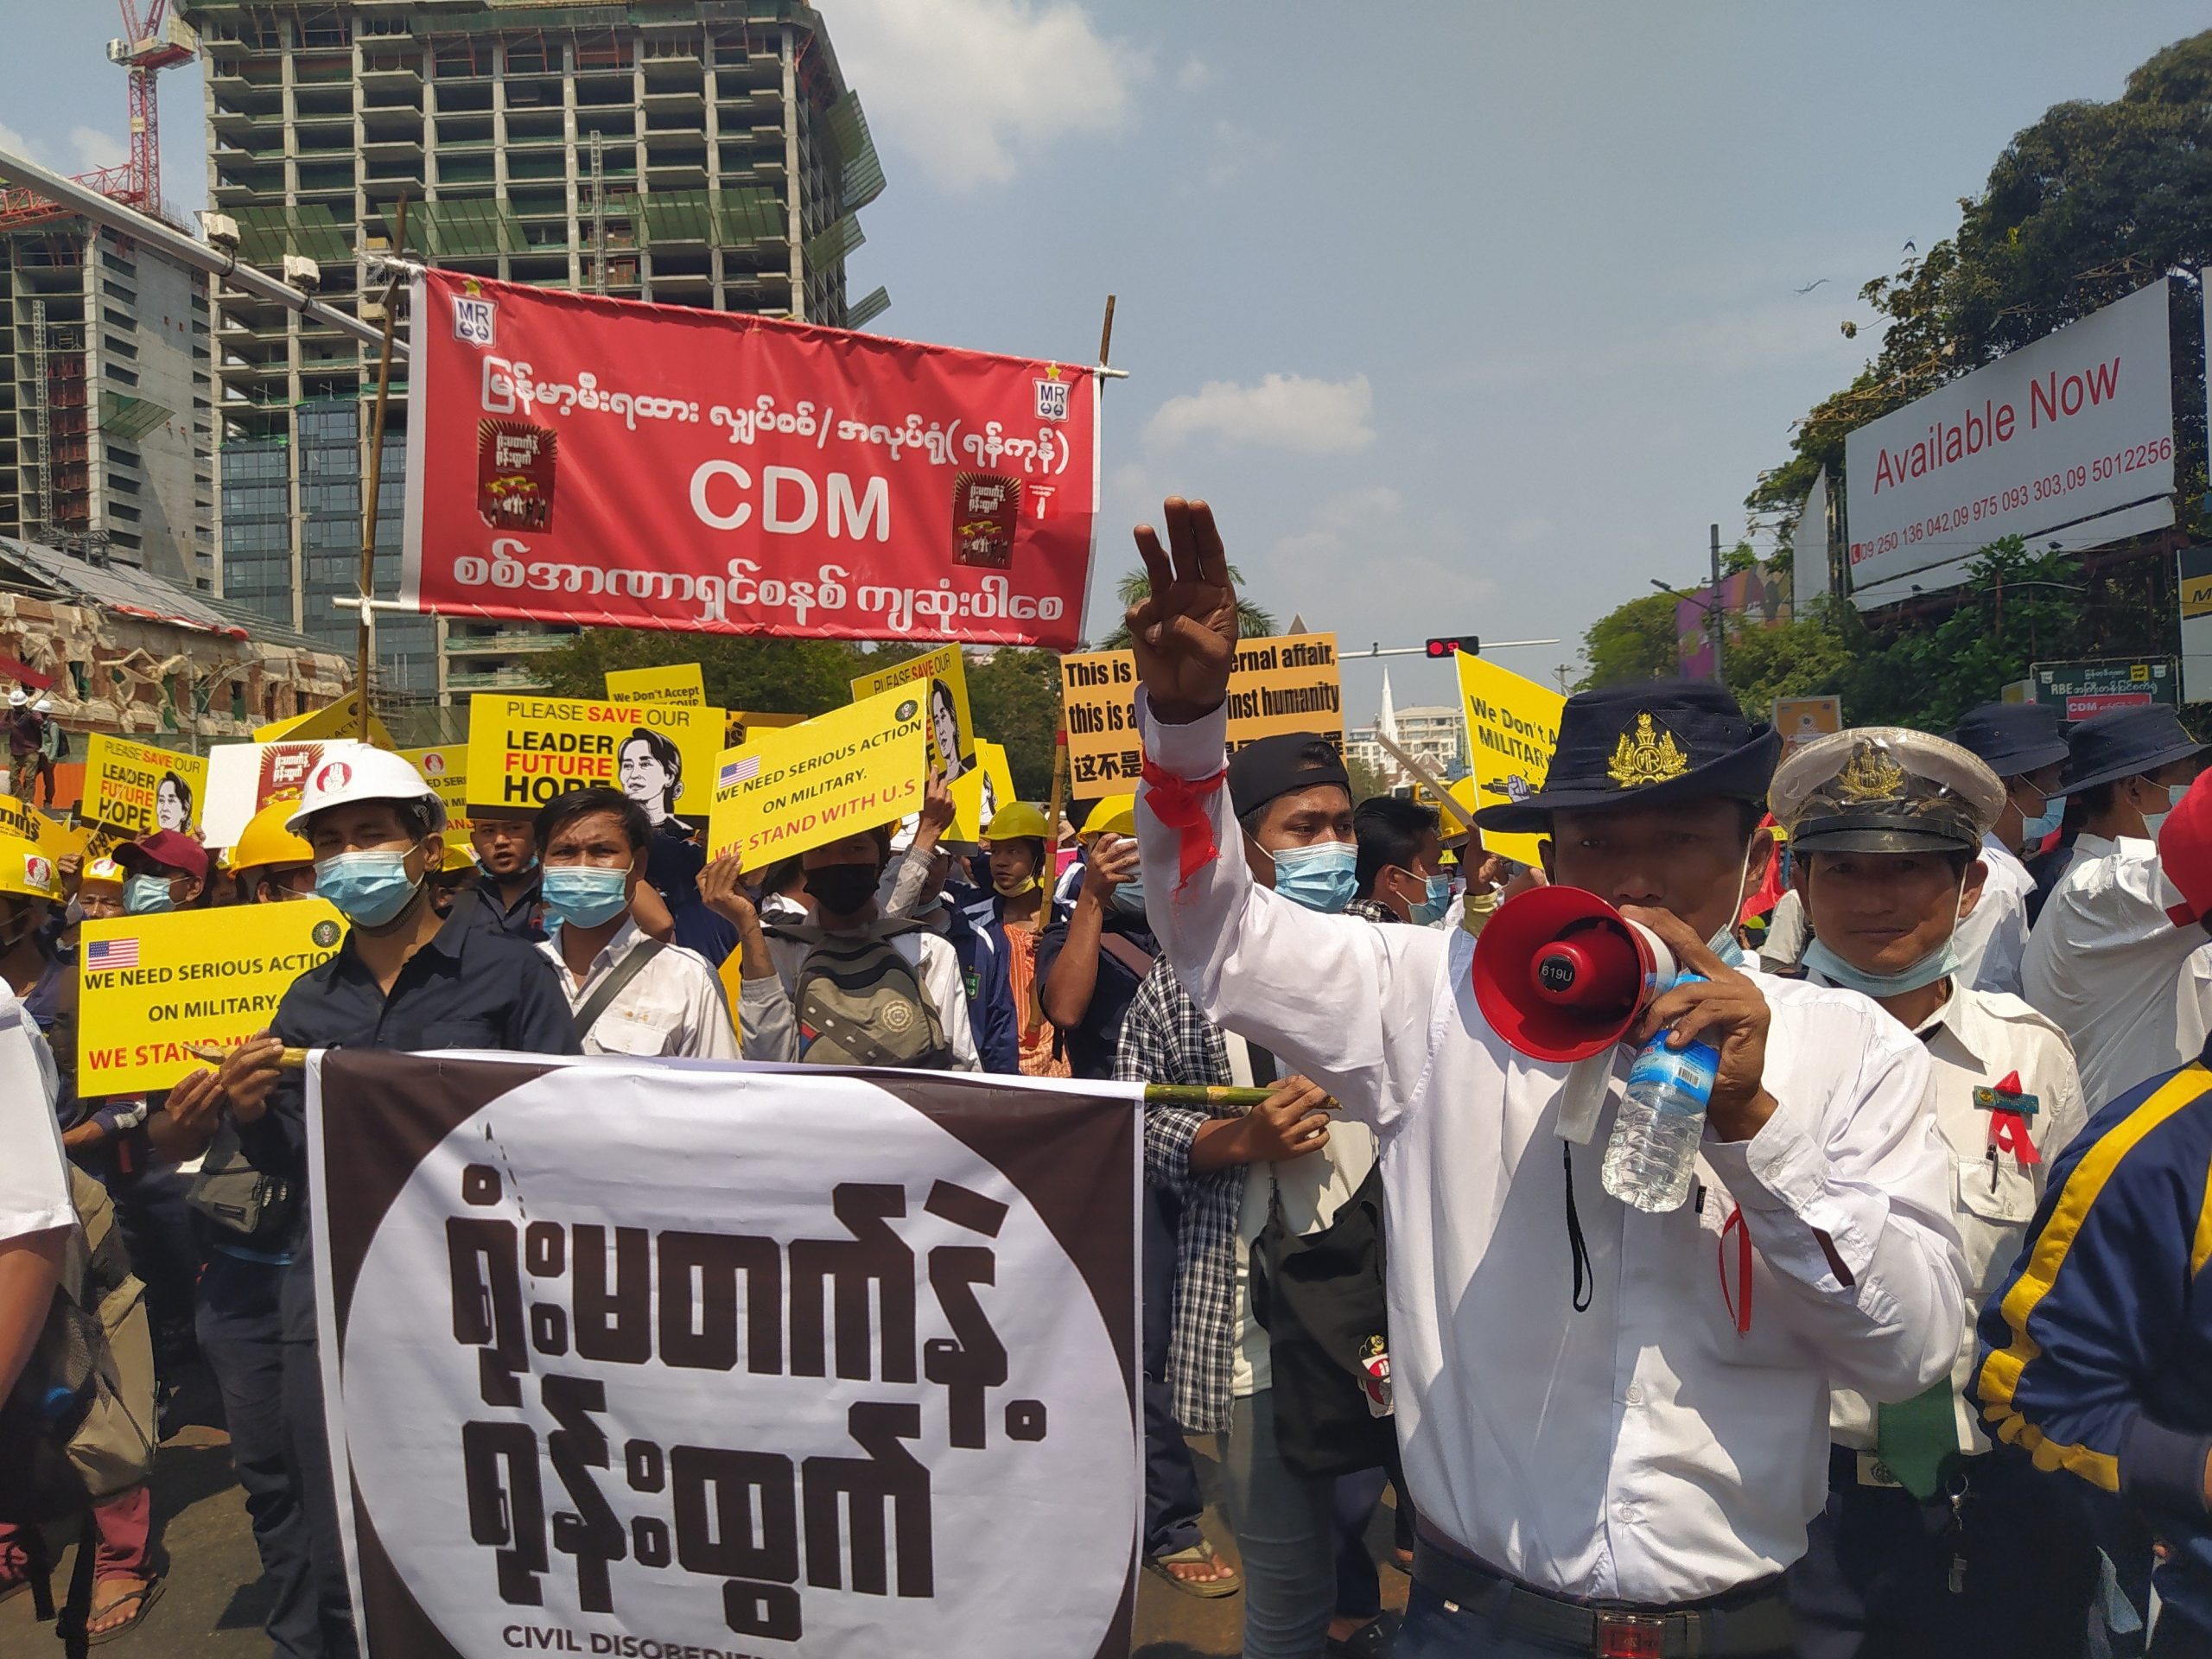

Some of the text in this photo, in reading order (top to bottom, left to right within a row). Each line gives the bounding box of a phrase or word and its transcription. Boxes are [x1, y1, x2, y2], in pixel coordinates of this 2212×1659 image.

[458, 302, 489, 326] MR
[482, 355, 699, 430] မြန်မာ့မီးရထား
[1041, 385, 1065, 403] MR
[1873, 357, 2120, 494] Available Now
[690, 459, 890, 542] CDM
[1878, 531, 1898, 556] 250
[1902, 522, 1923, 550] 136
[1973, 496, 1998, 522] 975
[2001, 485, 2029, 512] 093
[2092, 436, 2171, 482] 5012256
[454, 537, 1064, 633] စစ်အာဏာရှင်စနစ် ကျဆုံးပါစေ
[912, 660, 935, 680] SAVE
[934, 652, 951, 673] OUR
[1065, 662, 1109, 688] This
[1113, 659, 1132, 683] is
[1281, 641, 1336, 669] affair,
[613, 685, 699, 702] We Don't Accept
[1069, 702, 1103, 734] this
[1107, 700, 1121, 731] is
[1262, 681, 1340, 716] humanity
[2069, 702, 2097, 712] CDM
[506, 701, 690, 727] PLEASE SAVE OUR
[1470, 695, 1497, 723] We
[1500, 708, 1545, 744] Don't
[105, 741, 200, 774] PLEASE SAVE OUR
[506, 730, 613, 754] LEADER
[103, 763, 156, 790] LEADER
[505, 753, 613, 777] FUTURE
[716, 785, 739, 803] WE
[743, 769, 785, 793] NEED
[789, 745, 855, 778] SERIOUS
[860, 719, 922, 753] ACTION
[100, 780, 154, 807] FUTURE
[763, 767, 868, 815] ON MILITARY.
[99, 798, 152, 830] HOPE
[749, 814, 816, 852] STAND
[821, 791, 875, 825] WITH
[882, 779, 916, 804] U.S
[85, 972, 114, 990] WE
[120, 967, 173, 988] NEED
[178, 957, 264, 981] SERIOUS
[1541, 966, 1573, 982] 619U
[148, 1004, 178, 1022] ON
[89, 1047, 127, 1071] WE
[446, 1164, 1046, 1449] ရုံးမတက်နဲ့
[461, 1375, 934, 1641] ရုန်းထွက်
[503, 1625, 582, 1652] CIVIL
